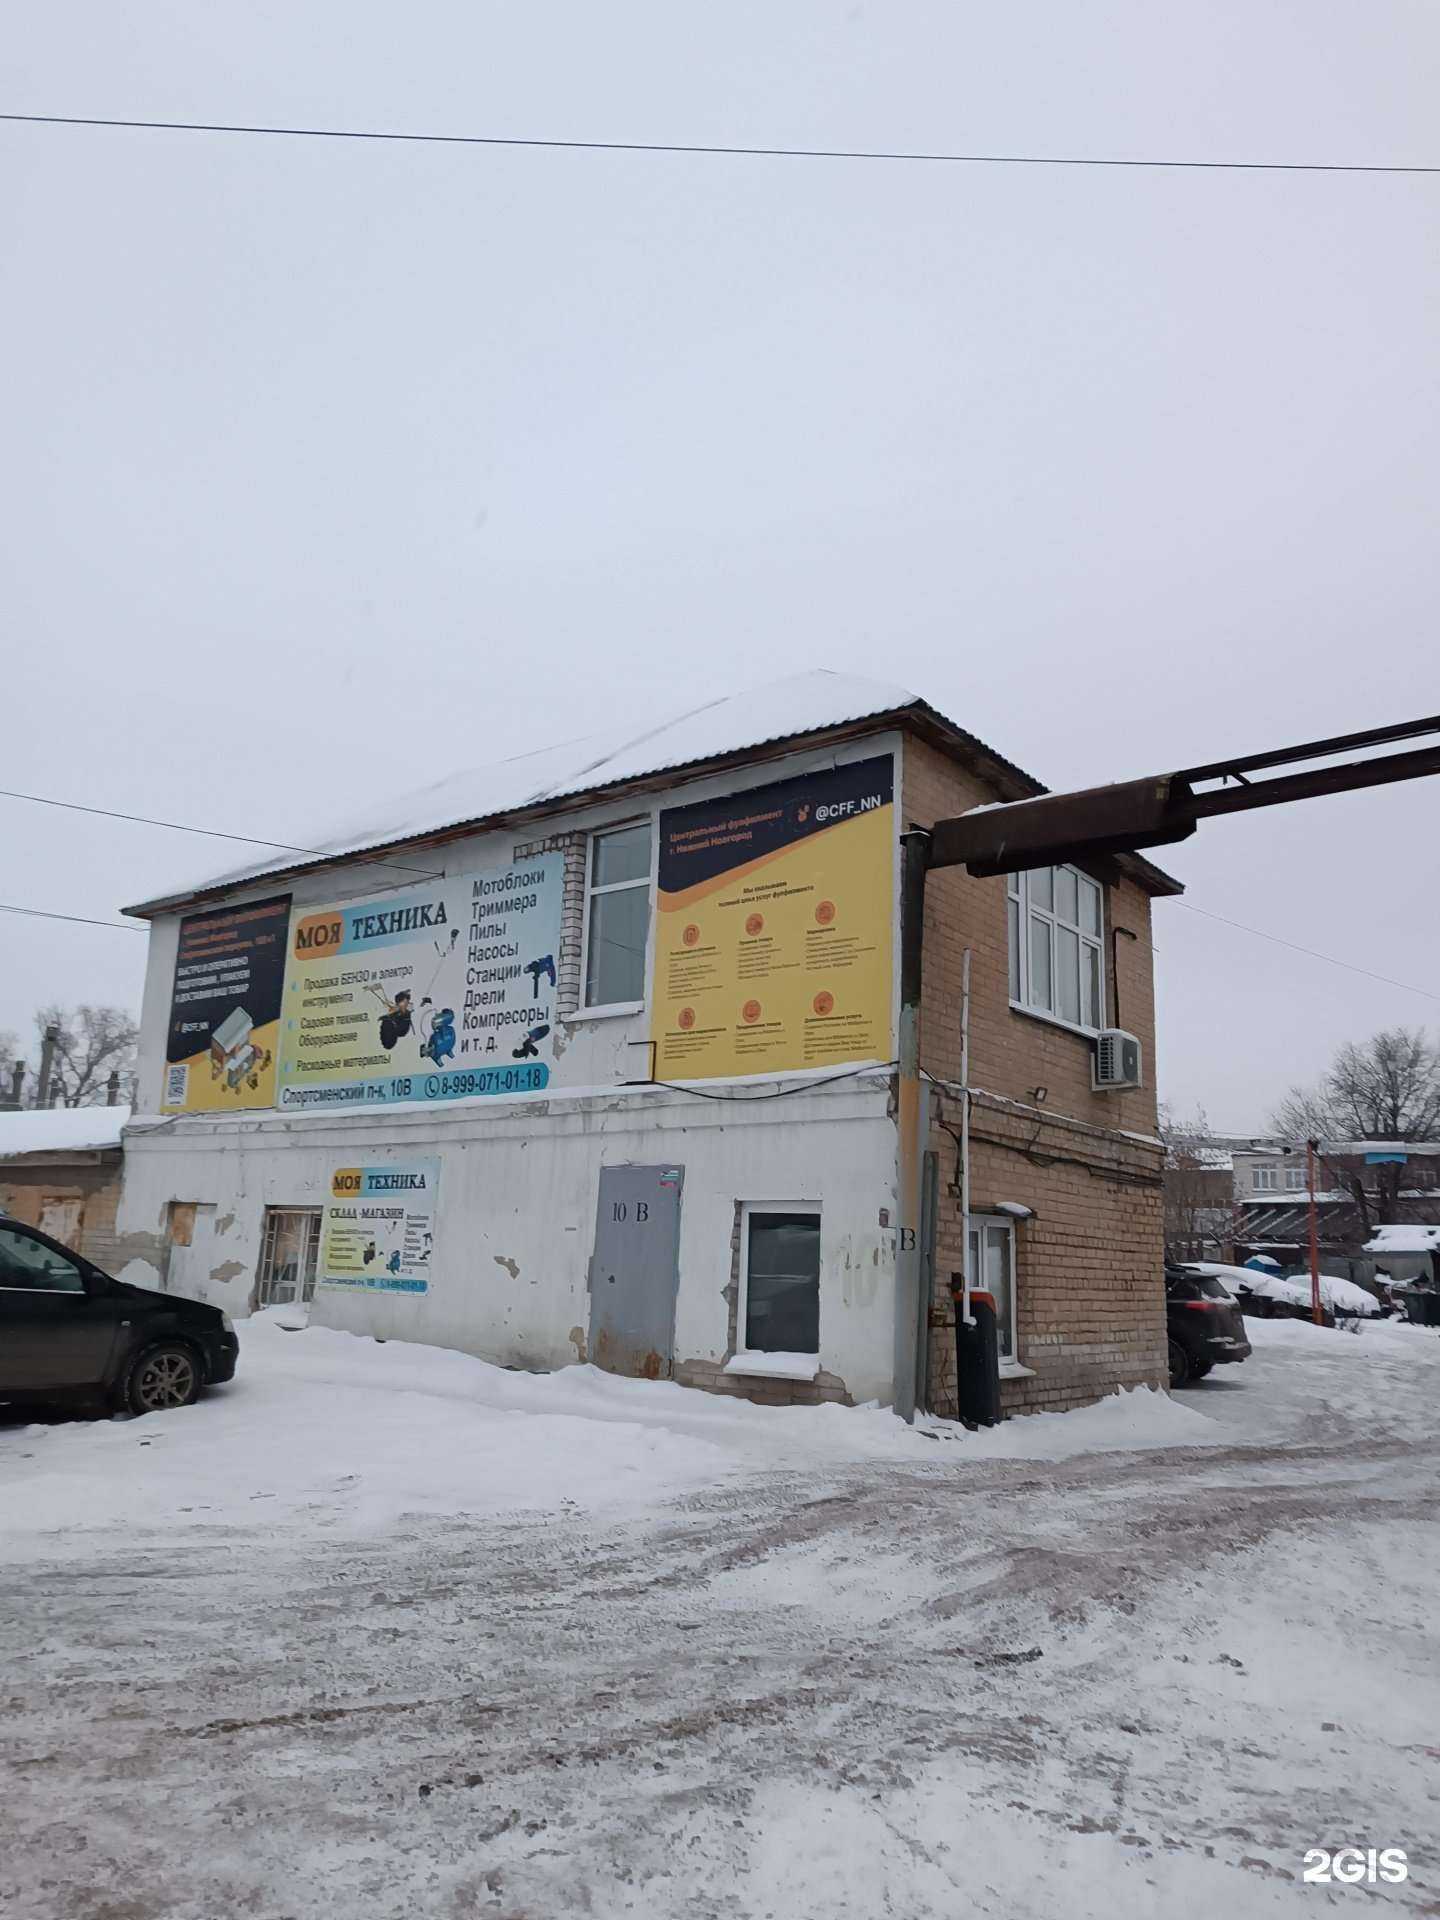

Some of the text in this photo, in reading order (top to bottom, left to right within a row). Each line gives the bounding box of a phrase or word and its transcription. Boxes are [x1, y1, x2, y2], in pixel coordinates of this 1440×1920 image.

[815, 795, 881, 821] @CFF_NN
[472, 869, 545, 898] Мотоблоки
[472, 893, 537, 923] Триммера
[296, 922, 342, 949] МОЯ
[352, 901, 448, 941] ТЕХНИКА
[469, 922, 507, 942] Пилы
[468, 942, 519, 963] Насосы
[341, 969, 370, 986] БЕНЗО
[379, 965, 414, 981] электро
[466, 964, 522, 985] Станции
[463, 989, 505, 1011] Дрели
[463, 1006, 550, 1031] Компресоры
[461, 1039, 470, 1053] и
[282, 1083, 366, 1107] Спортсменский
[390, 1078, 412, 1097] 10В
[441, 1068, 541, 1095] 8-999-071-01-18
[333, 1174, 426, 1190] МОЯ ТЕХНИКА
[612, 1202, 649, 1222] 10 В
[900, 1227, 916, 1251] В
